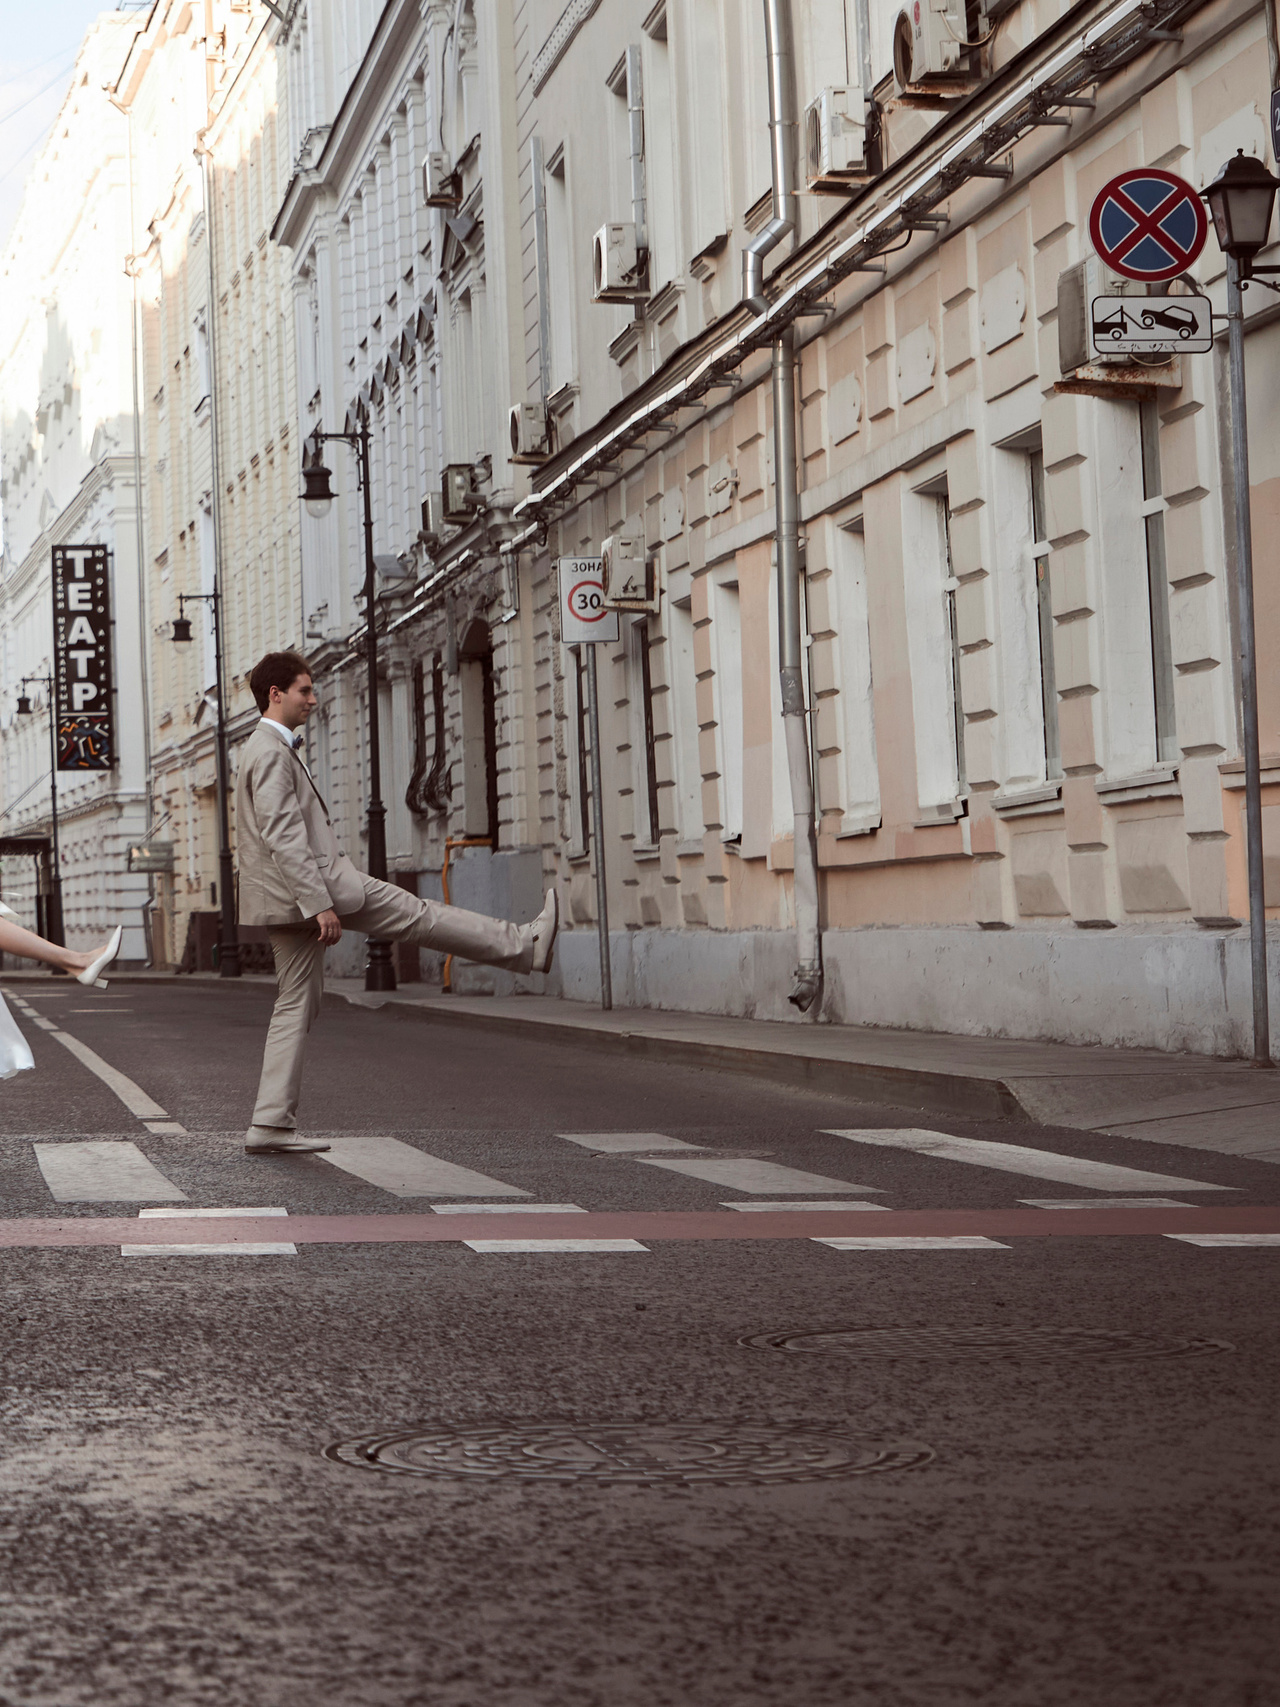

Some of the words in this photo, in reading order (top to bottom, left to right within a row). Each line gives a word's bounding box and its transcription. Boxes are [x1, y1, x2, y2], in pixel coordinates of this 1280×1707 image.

[95, 549, 105, 613] ЮНОГО
[578, 593, 601, 610] 30
[66, 550, 97, 711] ТЕАТР
[98, 629, 107, 710] АКТЕРА
